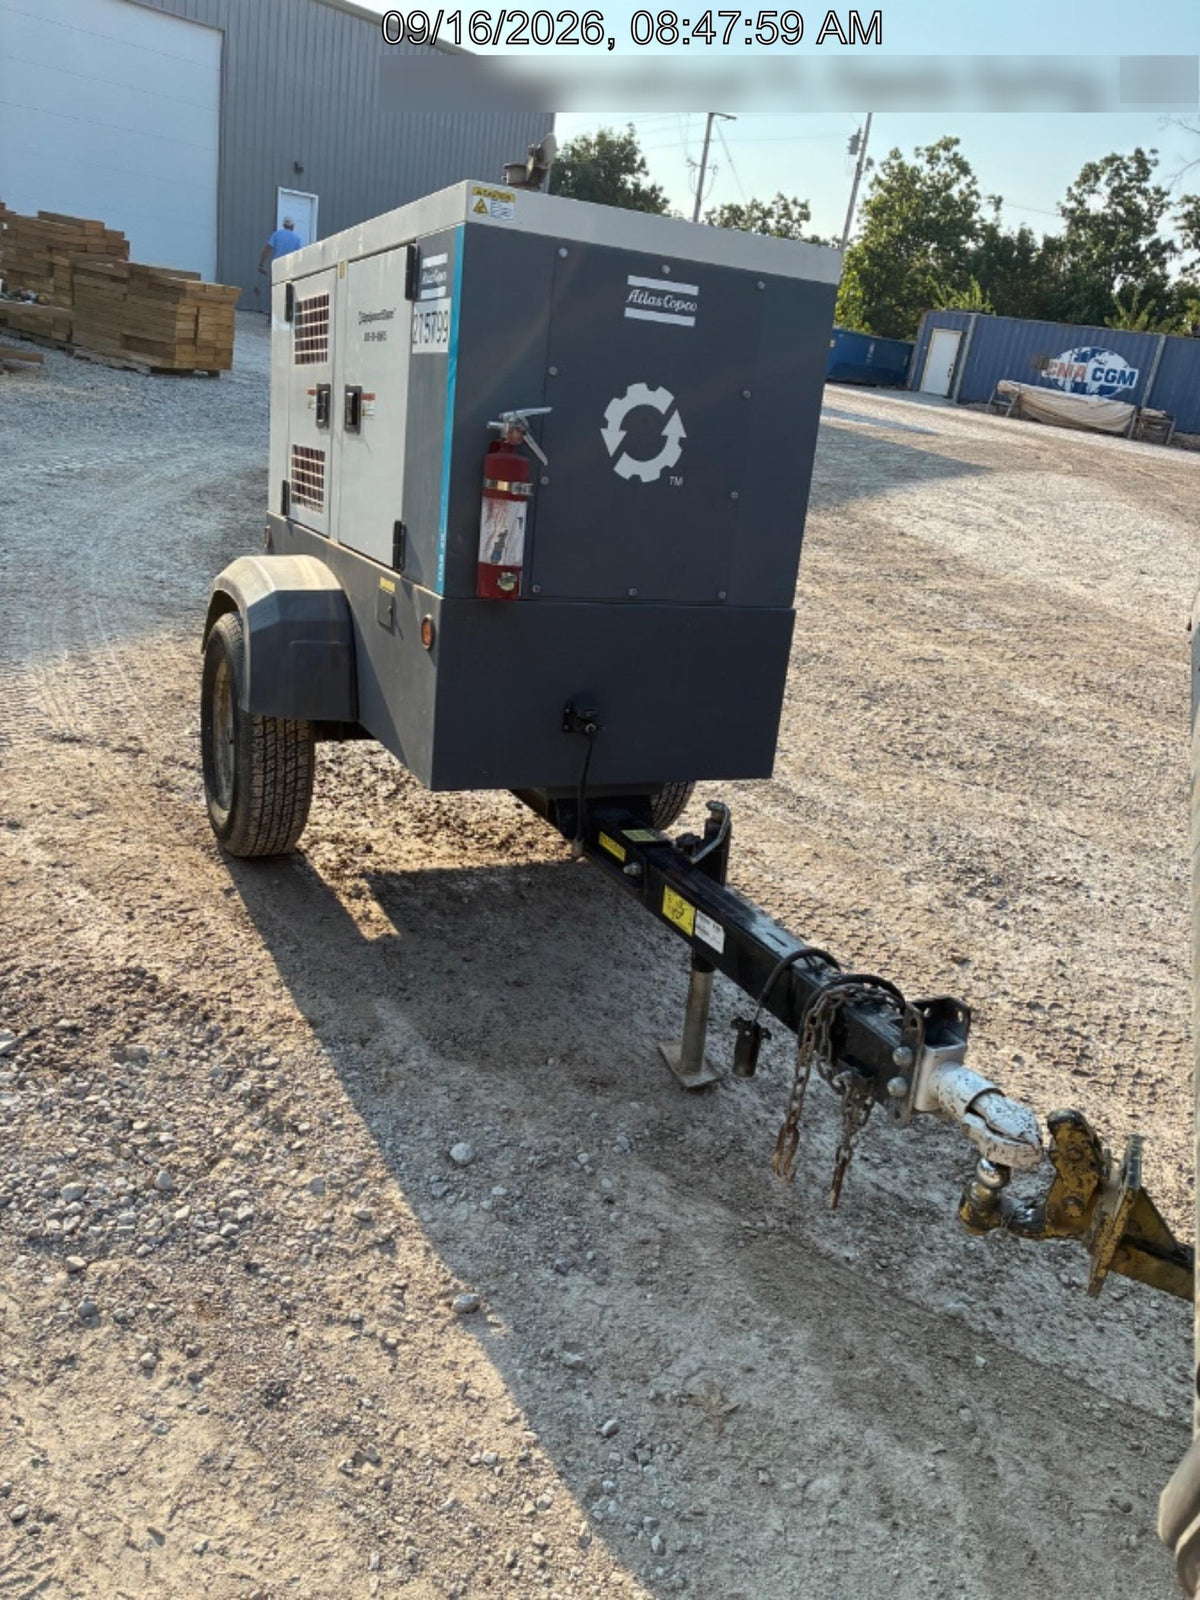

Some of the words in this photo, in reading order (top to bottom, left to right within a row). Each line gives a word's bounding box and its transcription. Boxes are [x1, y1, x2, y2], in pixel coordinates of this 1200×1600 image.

[625, 289, 662, 307] Atlas
[662, 294, 698, 312] Copco
[1091, 366, 1137, 386] CGM
[669, 475, 684, 487] TM
